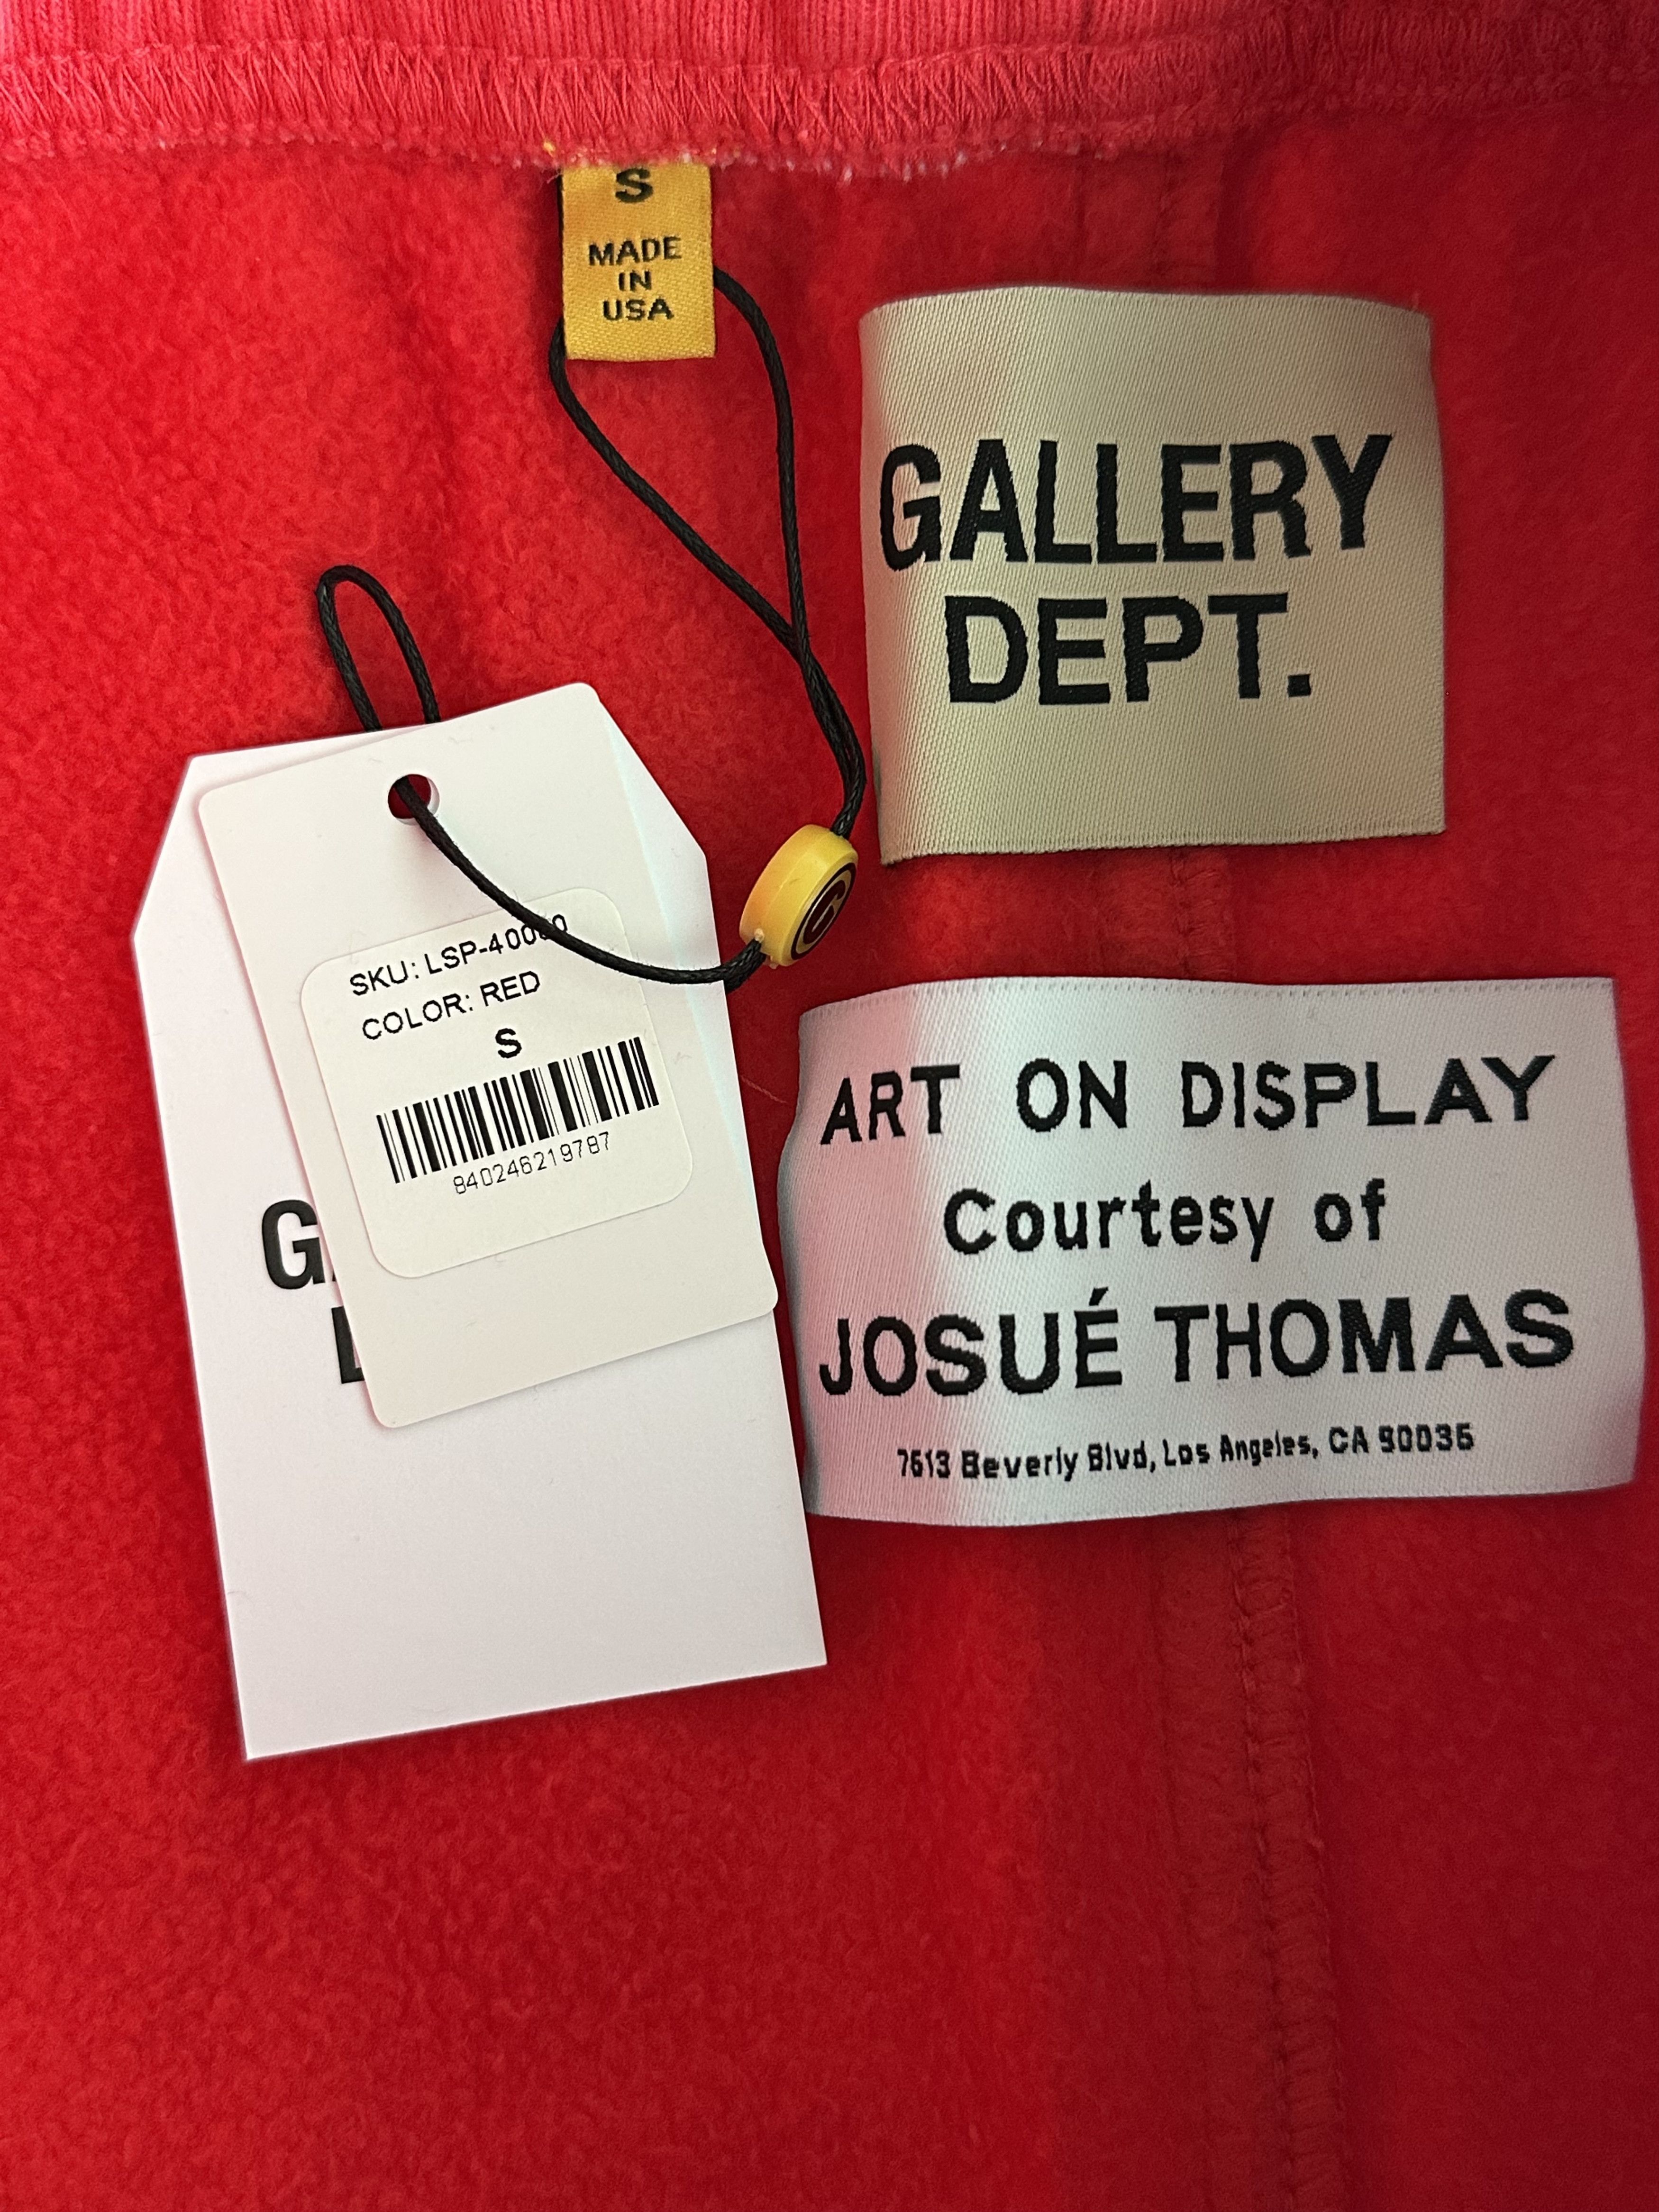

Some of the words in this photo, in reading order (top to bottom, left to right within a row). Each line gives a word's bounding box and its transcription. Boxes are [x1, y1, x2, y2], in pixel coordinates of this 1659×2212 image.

[615, 167, 654, 203] S
[589, 236, 682, 266] MADE
[619, 269, 652, 292] IN
[602, 297, 675, 321] USA
[880, 433, 1392, 572] GALLERY
[945, 592, 1312, 705] DEPT.
[350, 961, 420, 996] SKU:
[424, 914, 568, 974] LSP-4000
[362, 993, 474, 1040] COLOR:
[480, 971, 540, 1006] RED
[495, 1028, 522, 1059] S
[820, 1065, 960, 1145] ART
[1016, 1058, 1128, 1132] ON
[1181, 1055, 1556, 1131] DISPLAY
[453, 1131, 610, 1194] 840246219787
[943, 1179, 1275, 1262] Courtesy
[1314, 1178, 1386, 1242] of
[819, 1287, 1123, 1397] JOSUÉ
[1154, 1289, 1575, 1382] THOMAS
[897, 1448, 950, 1478] 7613
[961, 1447, 1078, 1482] Beverly
[1088, 1440, 1156, 1473] Blvd,
[1163, 1439, 1210, 1466] Los
[1220, 1430, 1319, 1466] Angeles,
[1329, 1426, 1370, 1454] CA
[1378, 1422, 1474, 1453] 90036
